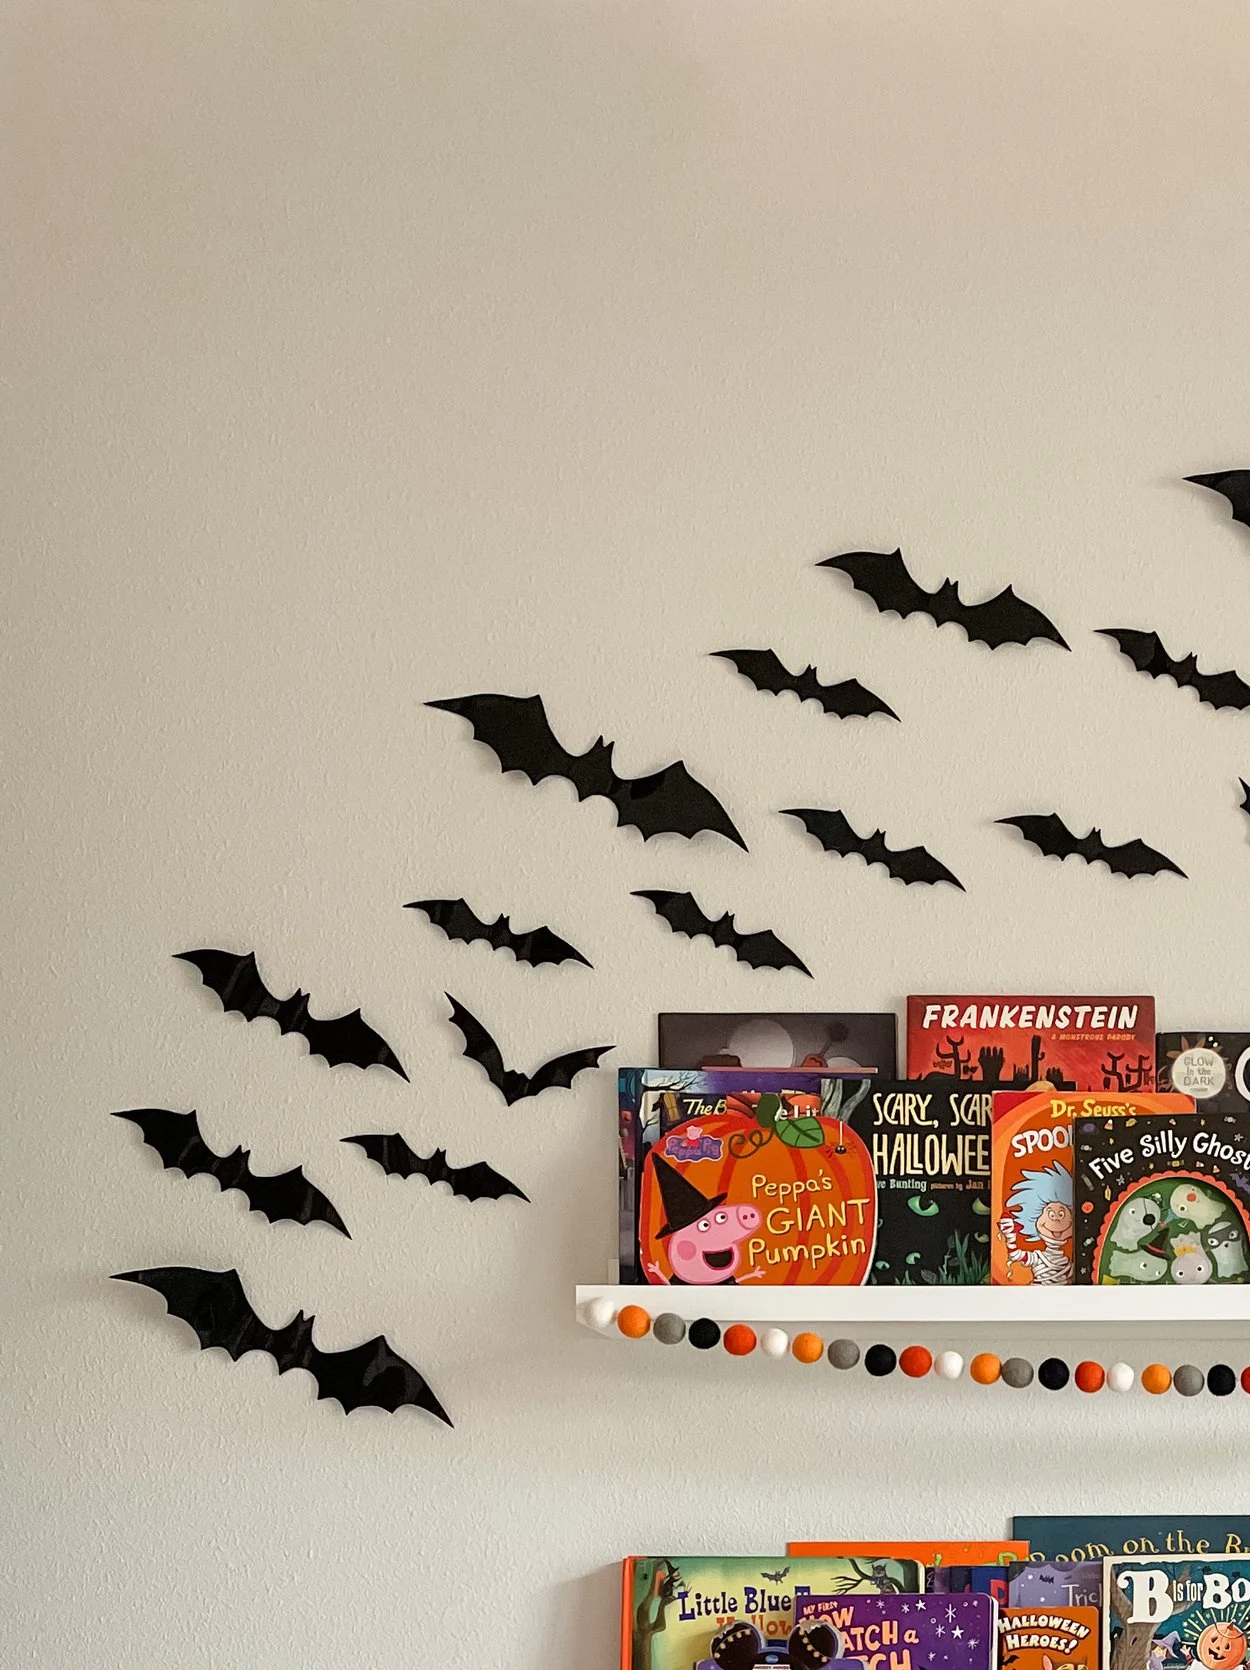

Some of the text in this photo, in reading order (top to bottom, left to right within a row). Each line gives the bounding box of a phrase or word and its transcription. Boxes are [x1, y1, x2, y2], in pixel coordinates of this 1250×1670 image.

[922, 1004, 1138, 1030] FRANKENSTEIN
[1060, 1033, 1104, 1041] MONSTROUS
[1107, 1033, 1136, 1041] PARODY
[1183, 1056, 1214, 1067] GLOW
[1183, 1076, 1215, 1087] DARK
[682, 1098, 713, 1116] The
[872, 1092, 992, 1129] SCARY, SCAR
[1050, 1099, 1077, 1118] Dr.
[872, 1133, 991, 1176] HALLOWEE
[1011, 1125, 1073, 1158] SPOO
[1089, 1147, 1134, 1180] Five
[1140, 1129, 1188, 1158] Silly
[751, 1168, 832, 1204] Peppa's
[889, 1178, 927, 1192] Bunting
[966, 1179, 984, 1189] Jan
[766, 1198, 870, 1235] GIANT
[748, 1233, 866, 1269] Pumpkin
[1122, 1537, 1160, 1554] on
[1165, 1530, 1210, 1554] the
[677, 1585, 792, 1621] Little Blue
[1116, 1569, 1174, 1624] B
[1185, 1580, 1204, 1602] for
[799, 1606, 855, 1629] OW
[998, 1614, 1090, 1638] HALLOWEEN
[843, 1620, 899, 1652] ATCH
[1005, 1634, 1079, 1654] HEROES!
